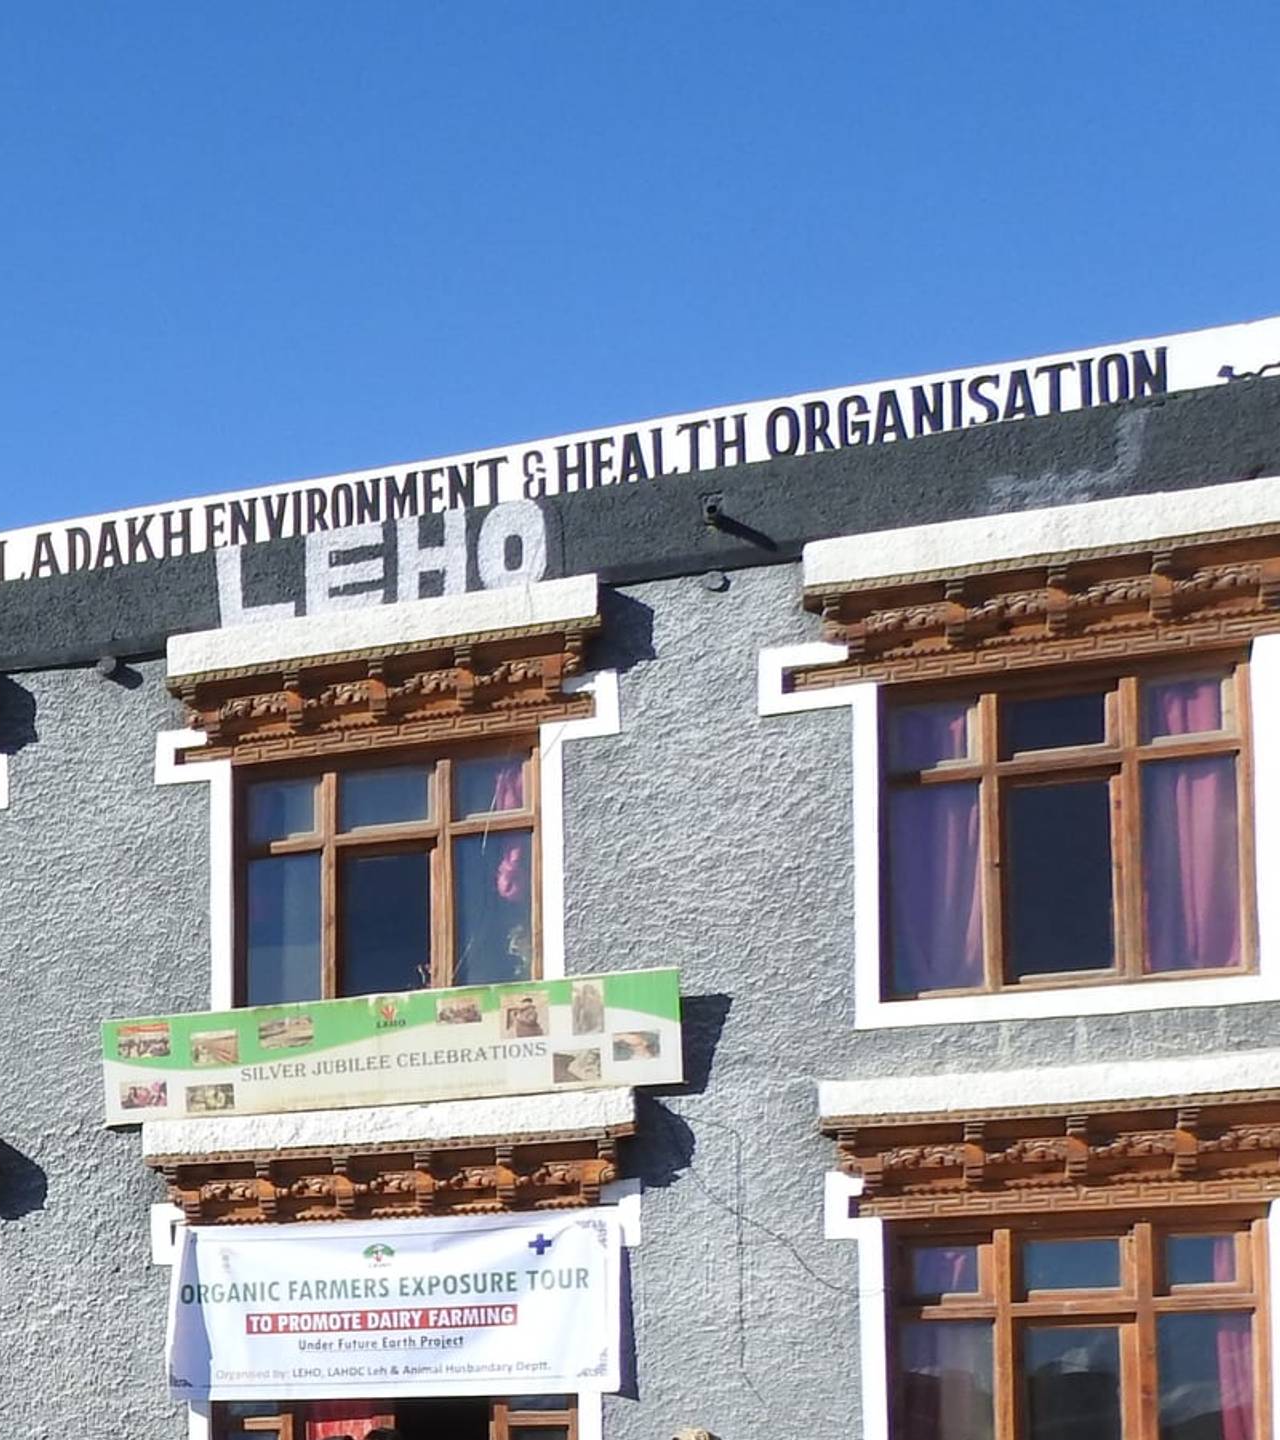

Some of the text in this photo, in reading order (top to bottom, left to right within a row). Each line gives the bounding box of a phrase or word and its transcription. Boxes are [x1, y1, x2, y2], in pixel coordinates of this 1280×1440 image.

[204, 455, 509, 551] ENVIRONMENT
[523, 449, 547, 500] &
[554, 412, 748, 494] HEALTH
[765, 346, 1168, 457] ORGANISATION
[214, 498, 548, 629] LEHO
[240, 1041, 548, 1083] SILVER JUBILEE CELEBRATIONS
[180, 1267, 590, 1305] ORGANIC FARMERS EXPOSURE TOUR
[249, 1306, 515, 1333] TO PROMOTE DAIRY FARMING
[298, 1335, 464, 1351] Under Future Earth Project
[367, 1365, 388, 1376] Leh
[403, 1363, 443, 1375] Animal
